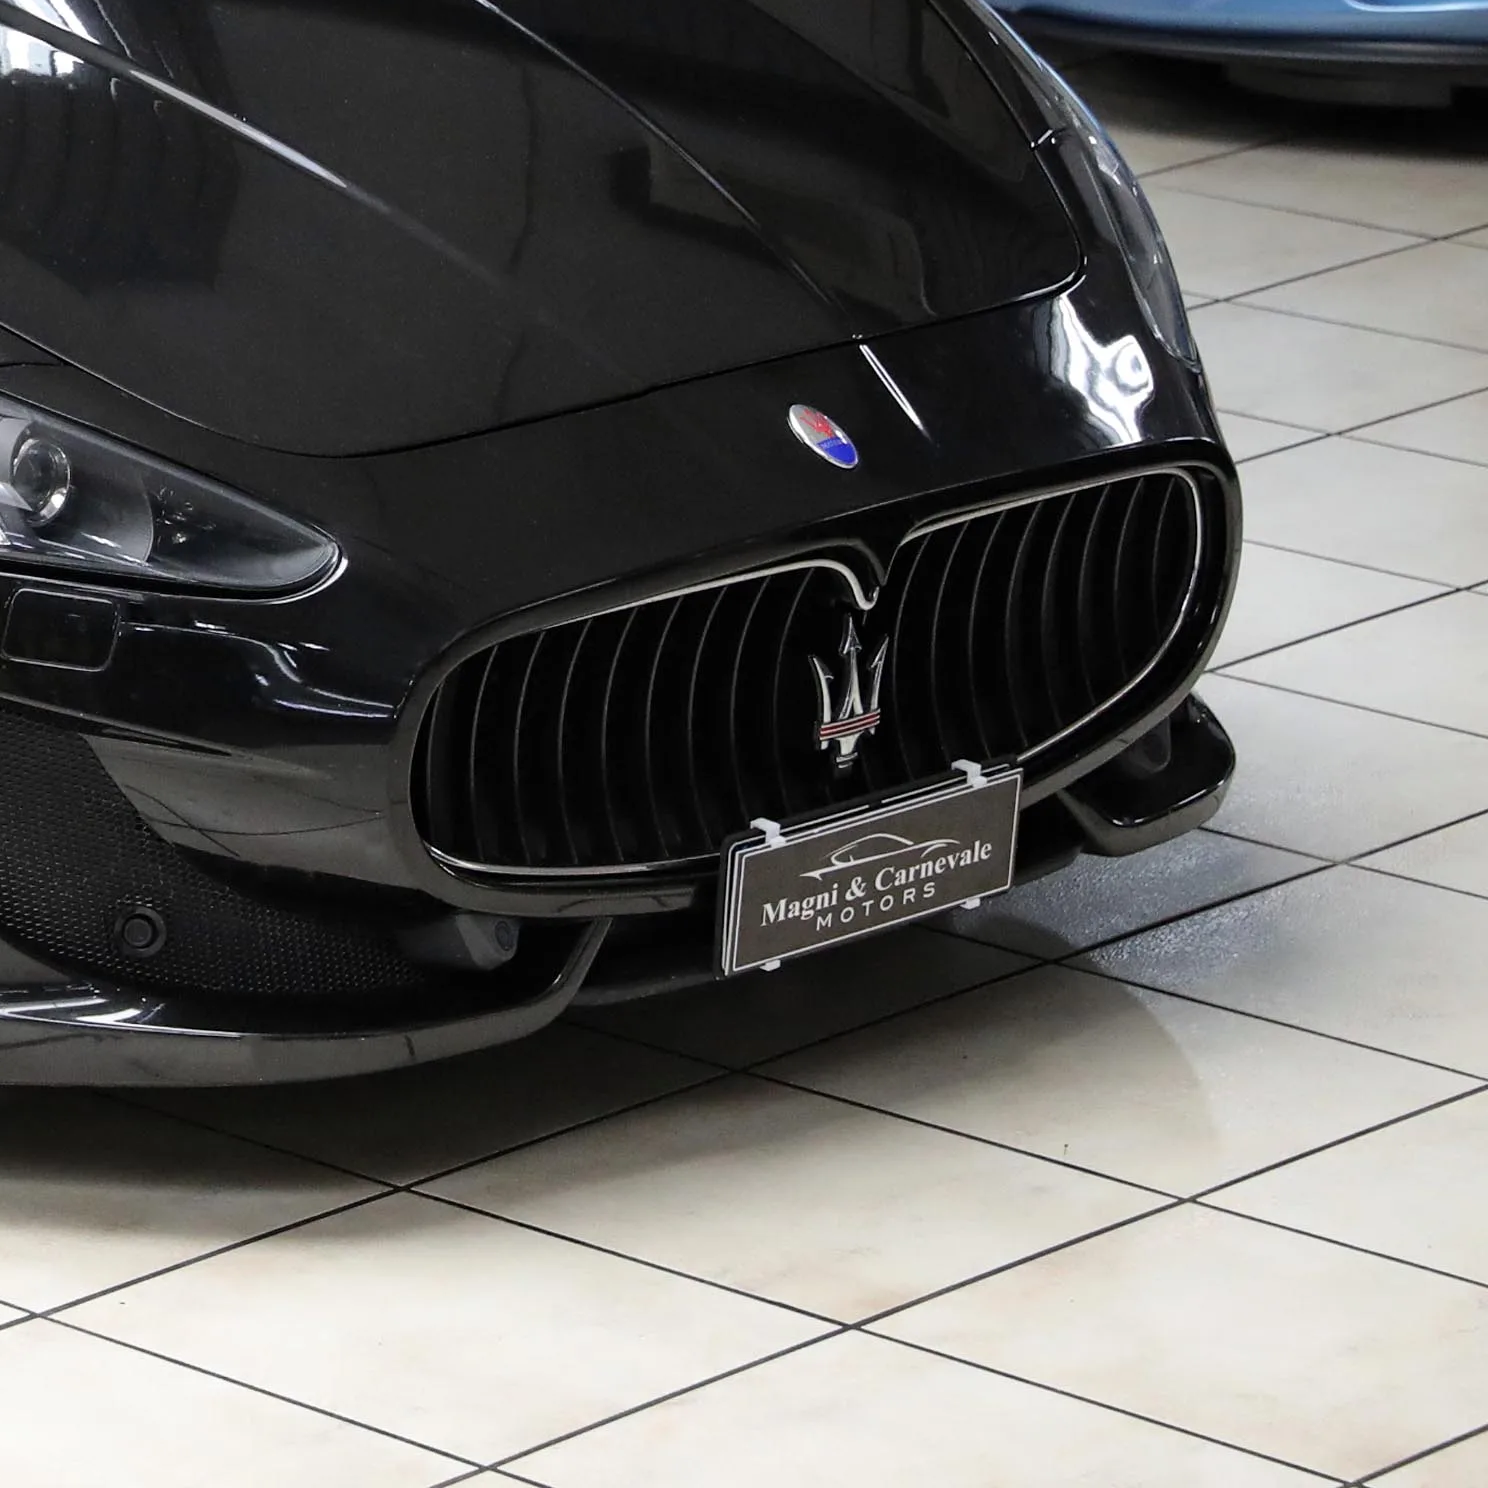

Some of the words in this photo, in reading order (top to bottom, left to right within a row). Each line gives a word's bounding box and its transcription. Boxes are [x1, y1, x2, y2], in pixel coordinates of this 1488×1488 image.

[760, 883, 839, 927] Magni
[844, 876, 867, 901] &
[874, 839, 993, 892] Carnevale
[816, 881, 936, 931] MOTORS
